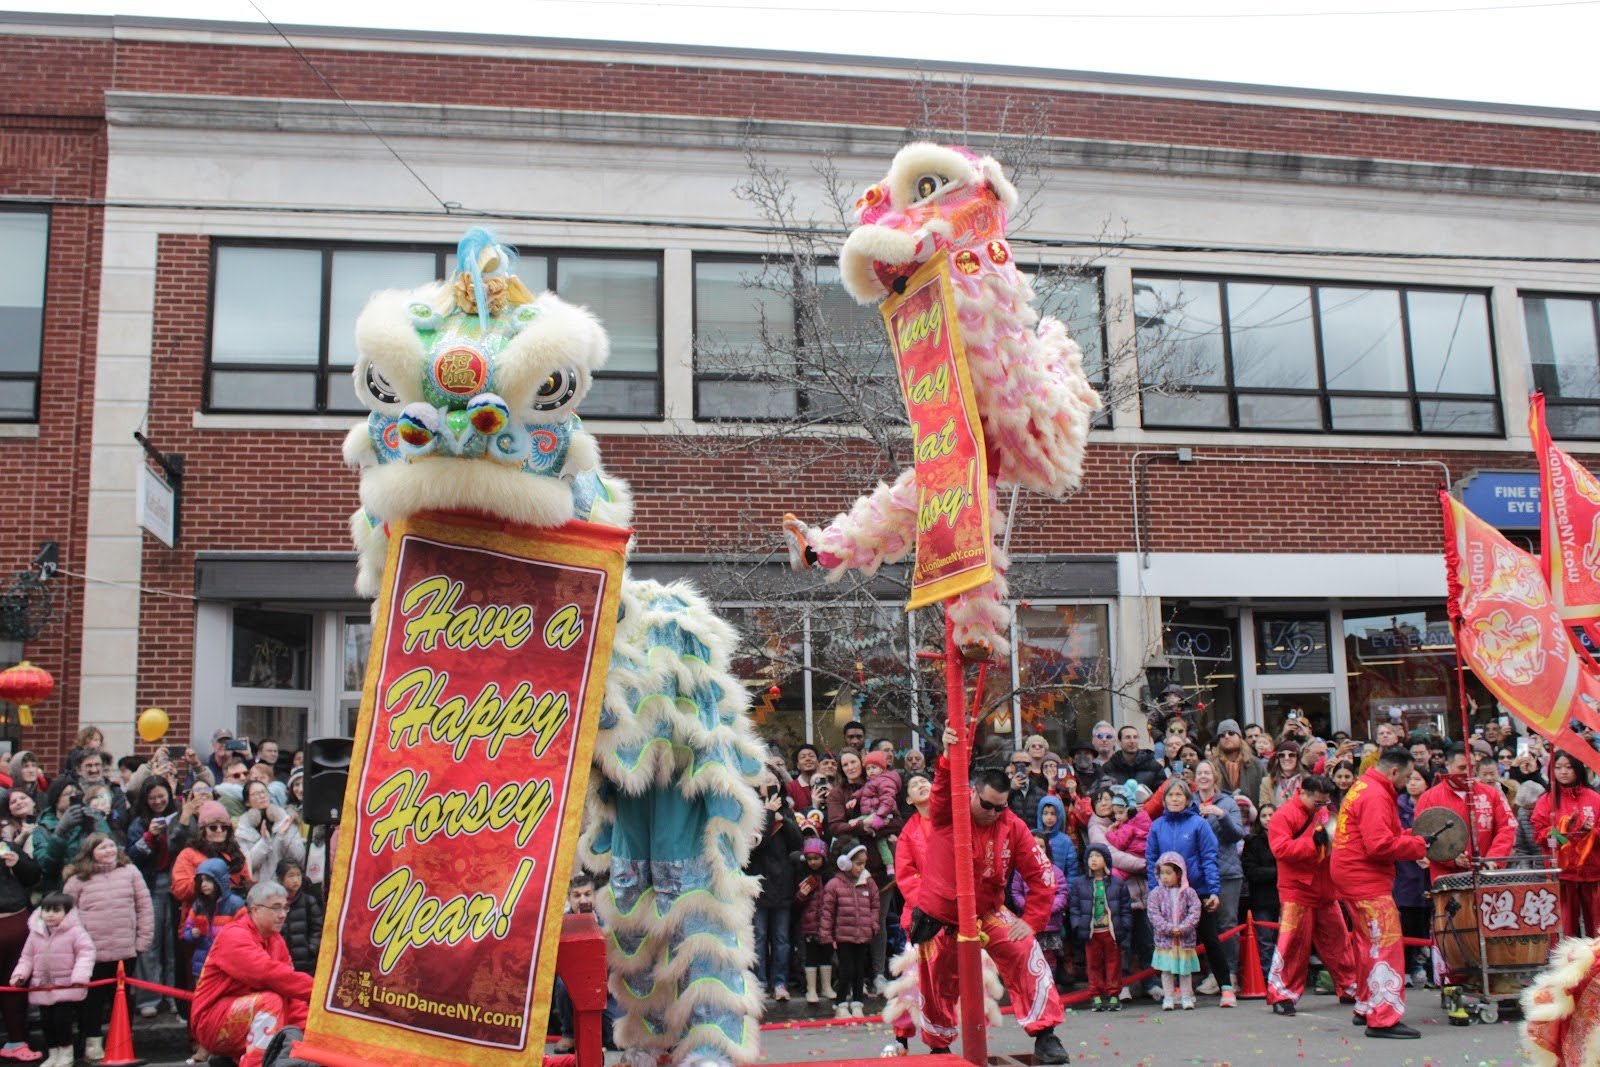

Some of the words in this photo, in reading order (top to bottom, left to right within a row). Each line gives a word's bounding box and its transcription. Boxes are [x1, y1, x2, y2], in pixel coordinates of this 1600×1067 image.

[897, 300, 942, 353] ung
[917, 456, 977, 535] hoy!
[1495, 486, 1526, 498] FINE
[1529, 486, 1541, 498] E
[1507, 502, 1534, 513] EYE
[921, 546, 985, 573] LionDanceNY.com
[401, 575, 534, 655] Have
[543, 603, 584, 652] a
[1371, 634, 1402, 648] EYE
[385, 666, 571, 763] Happy
[366, 767, 554, 857] Horsey
[368, 856, 536, 976] Year!
[371, 985, 523, 1029] LionDanceNY.com
